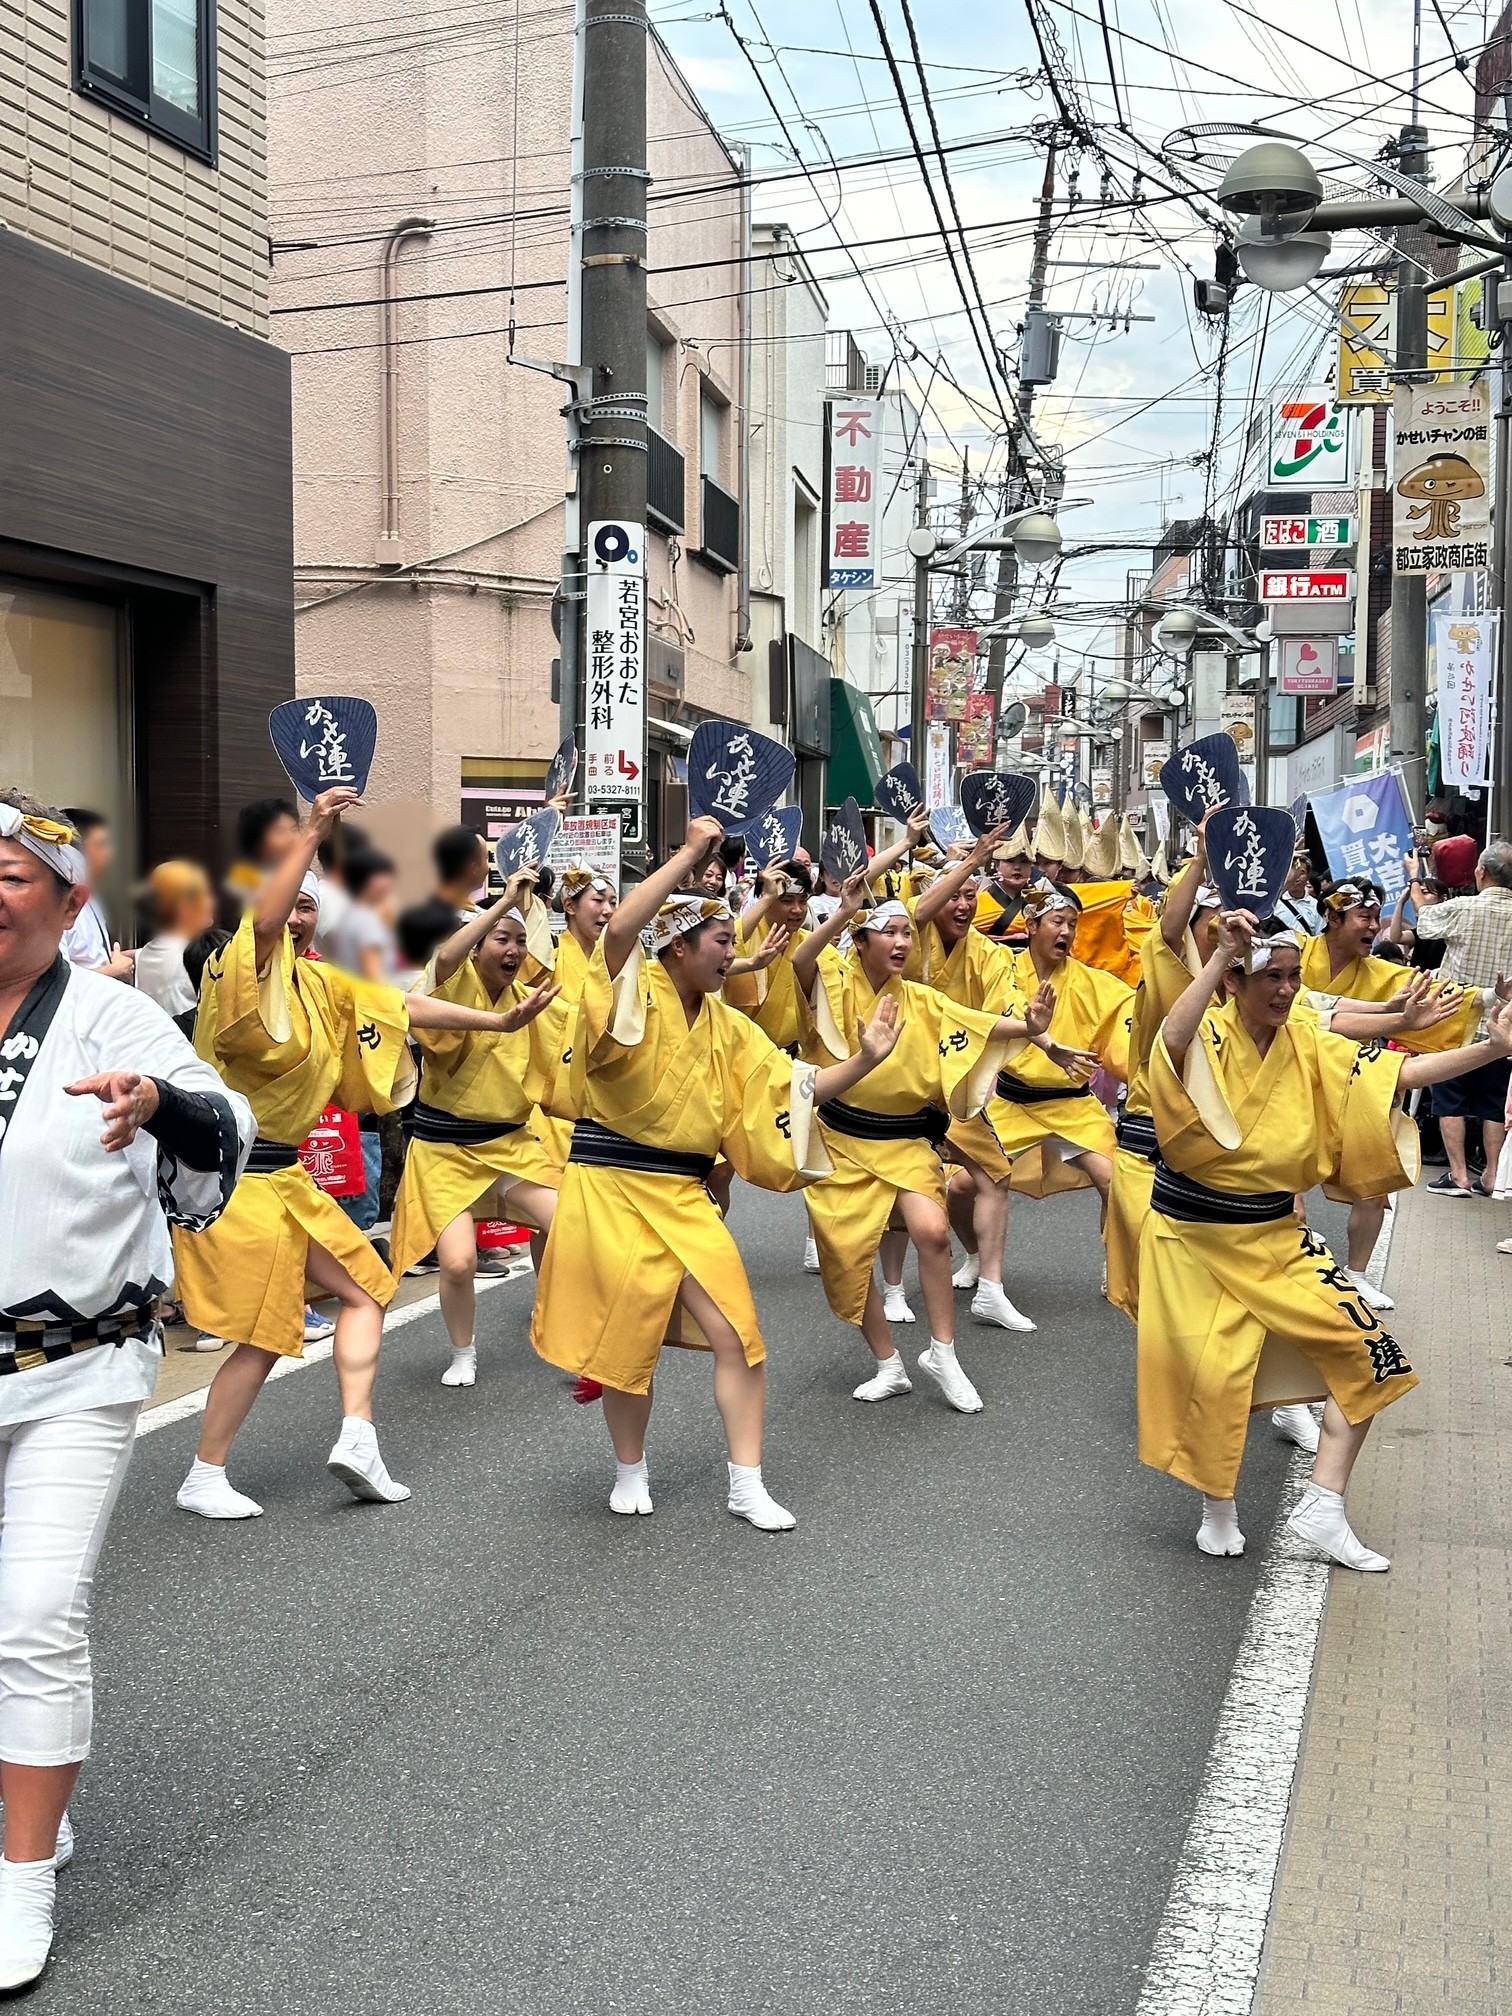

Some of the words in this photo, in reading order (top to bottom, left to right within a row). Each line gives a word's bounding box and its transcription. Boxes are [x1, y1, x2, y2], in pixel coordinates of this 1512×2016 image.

[1421, 399, 1481, 415] ようこそ!!
[1396, 426, 1487, 446] かせいチャンの街
[835, 411, 872, 558] 不動産
[1265, 520, 1305, 544] たばこ
[1315, 519, 1340, 543] 酒
[1396, 542, 1487, 571] 都立家政商店街
[830, 572, 873, 585] タケシン
[618, 579, 639, 705] 若宮おおた
[590, 630, 614, 730] 整形外科
[588, 785, 640, 795] 03-5327-8111
